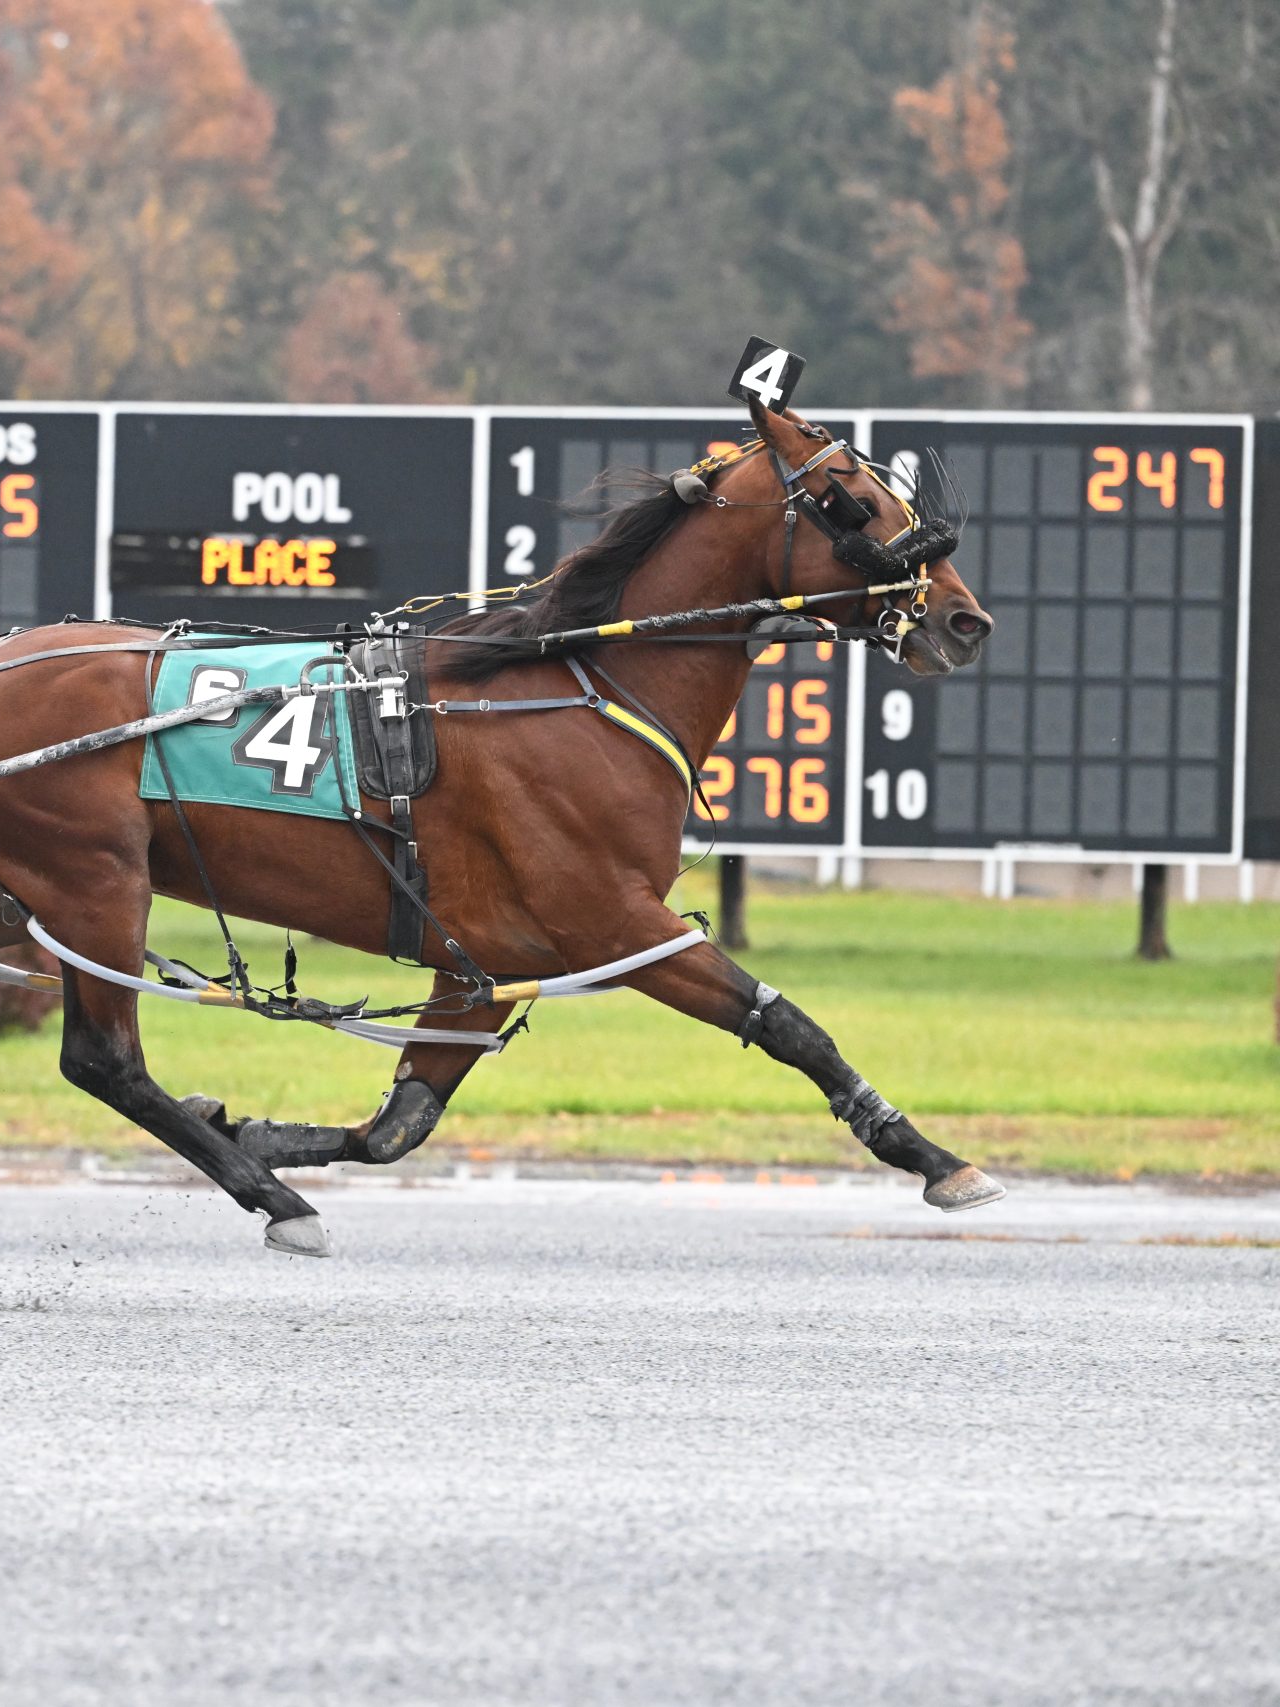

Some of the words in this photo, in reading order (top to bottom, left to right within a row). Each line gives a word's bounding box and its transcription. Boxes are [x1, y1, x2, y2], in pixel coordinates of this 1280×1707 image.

[740, 348, 784, 408] 4
[232, 472, 352, 523] POOL
[509, 446, 536, 497] 1
[1087, 446, 1226, 512] 247
[0, 474, 39, 538] 5
[202, 537, 337, 587] PLACE
[504, 525, 537, 577] 2
[718, 679, 832, 745] 15
[881, 688, 914, 741] 9
[245, 694, 321, 788] 4
[693, 755, 830, 823] 276
[864, 768, 928, 821] 10
